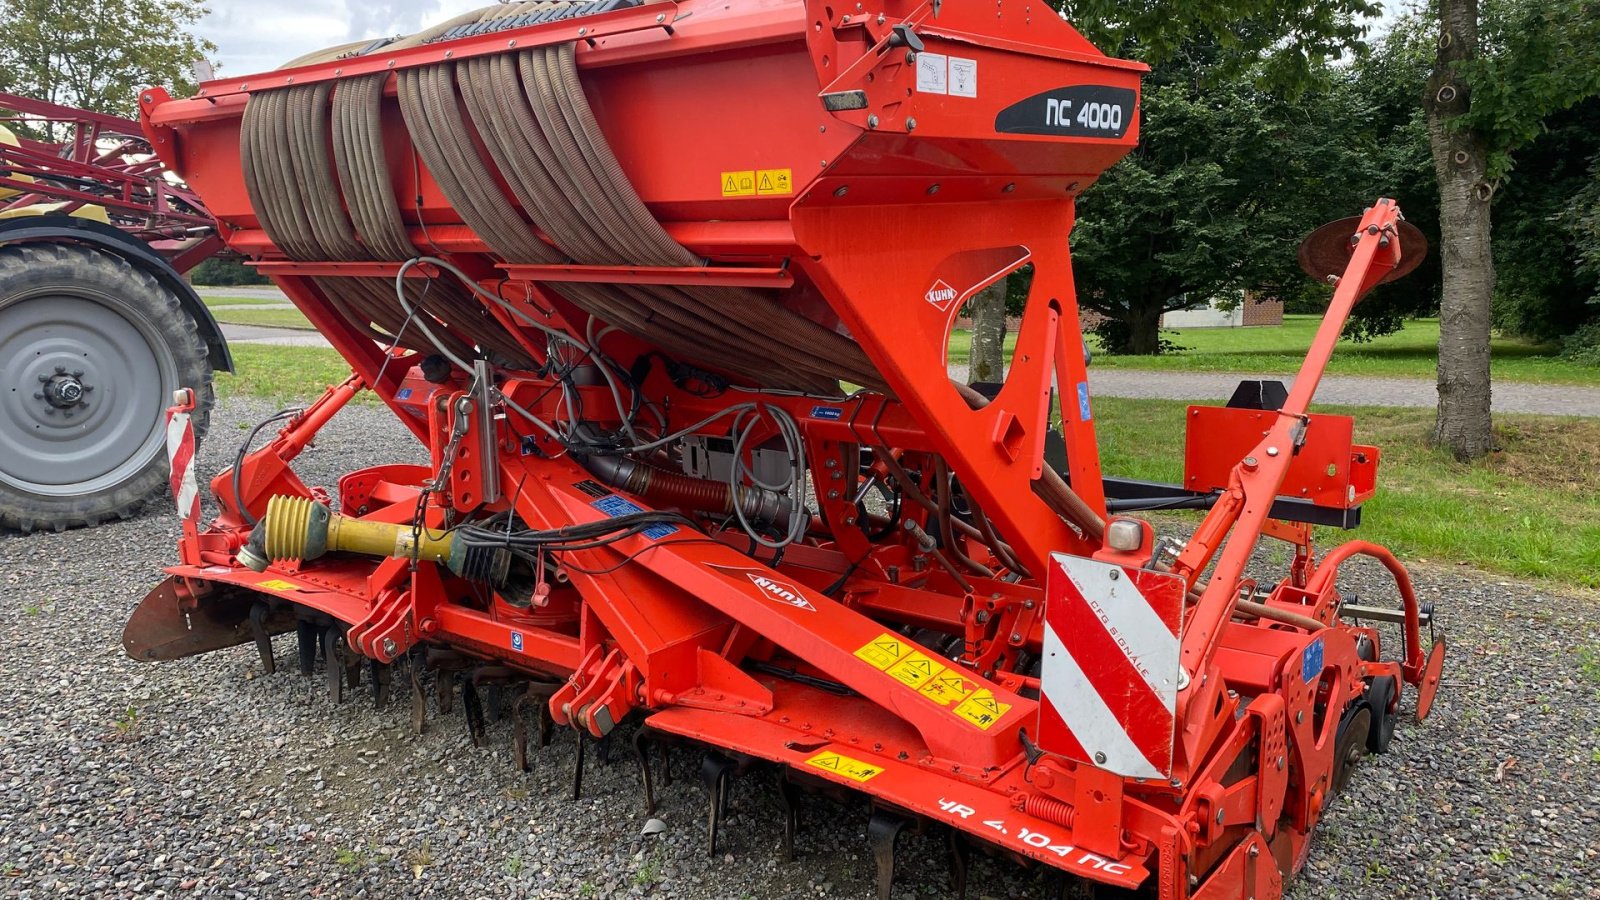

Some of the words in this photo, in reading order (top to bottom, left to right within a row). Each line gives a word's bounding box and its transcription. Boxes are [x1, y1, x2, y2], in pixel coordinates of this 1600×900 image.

[1077, 102, 1122, 130] 4000
[928, 288, 954, 303] KUHN
[754, 577, 808, 607] KUHN
[1090, 600, 1109, 624] CFG
